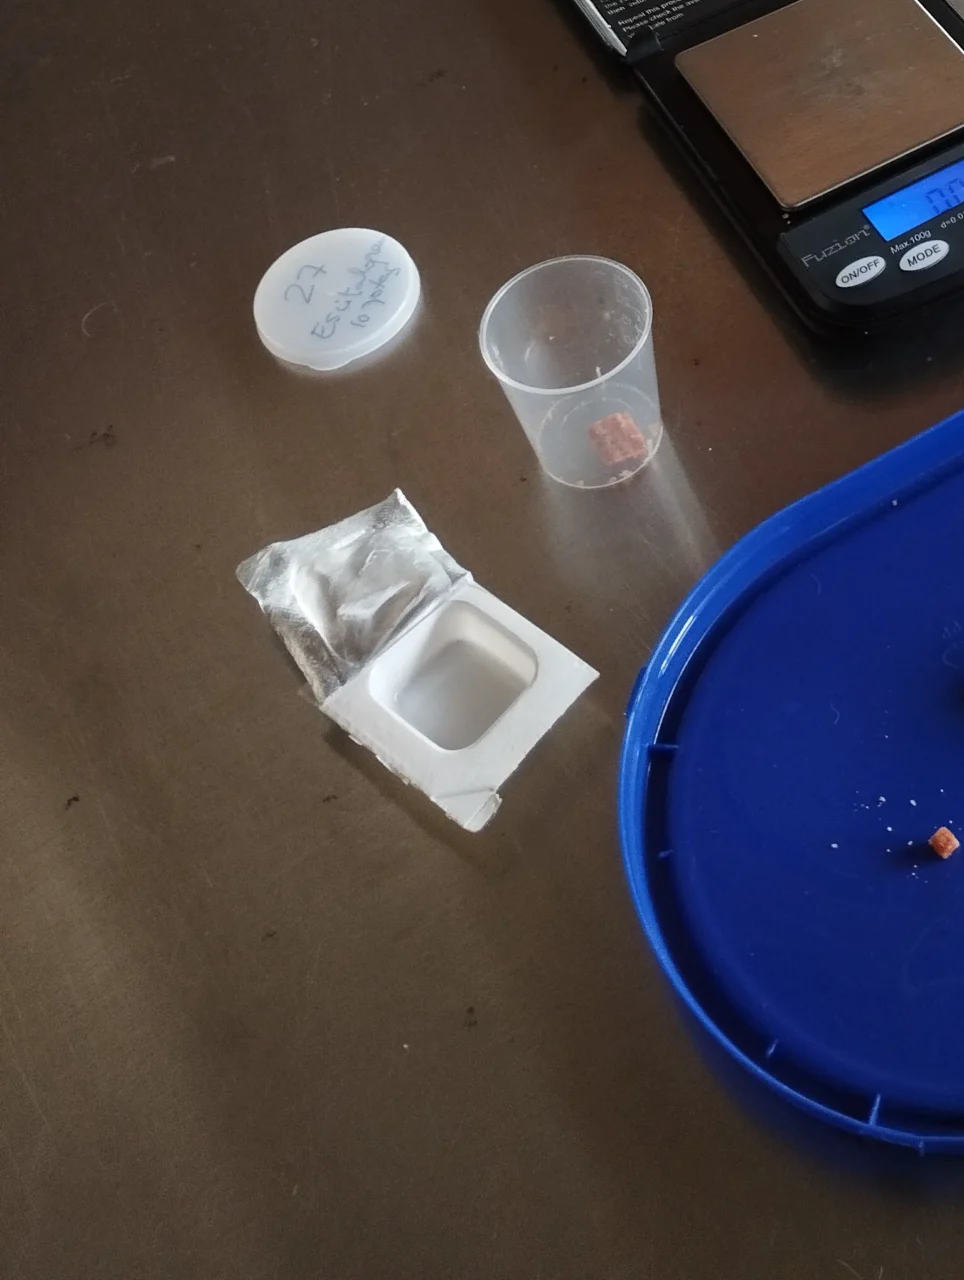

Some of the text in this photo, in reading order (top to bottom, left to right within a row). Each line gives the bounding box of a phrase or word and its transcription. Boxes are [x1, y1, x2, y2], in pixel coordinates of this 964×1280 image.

[907, 243, 942, 267] MODE
[841, 258, 880, 284] ON/OFF
[284, 264, 327, 305] 27
